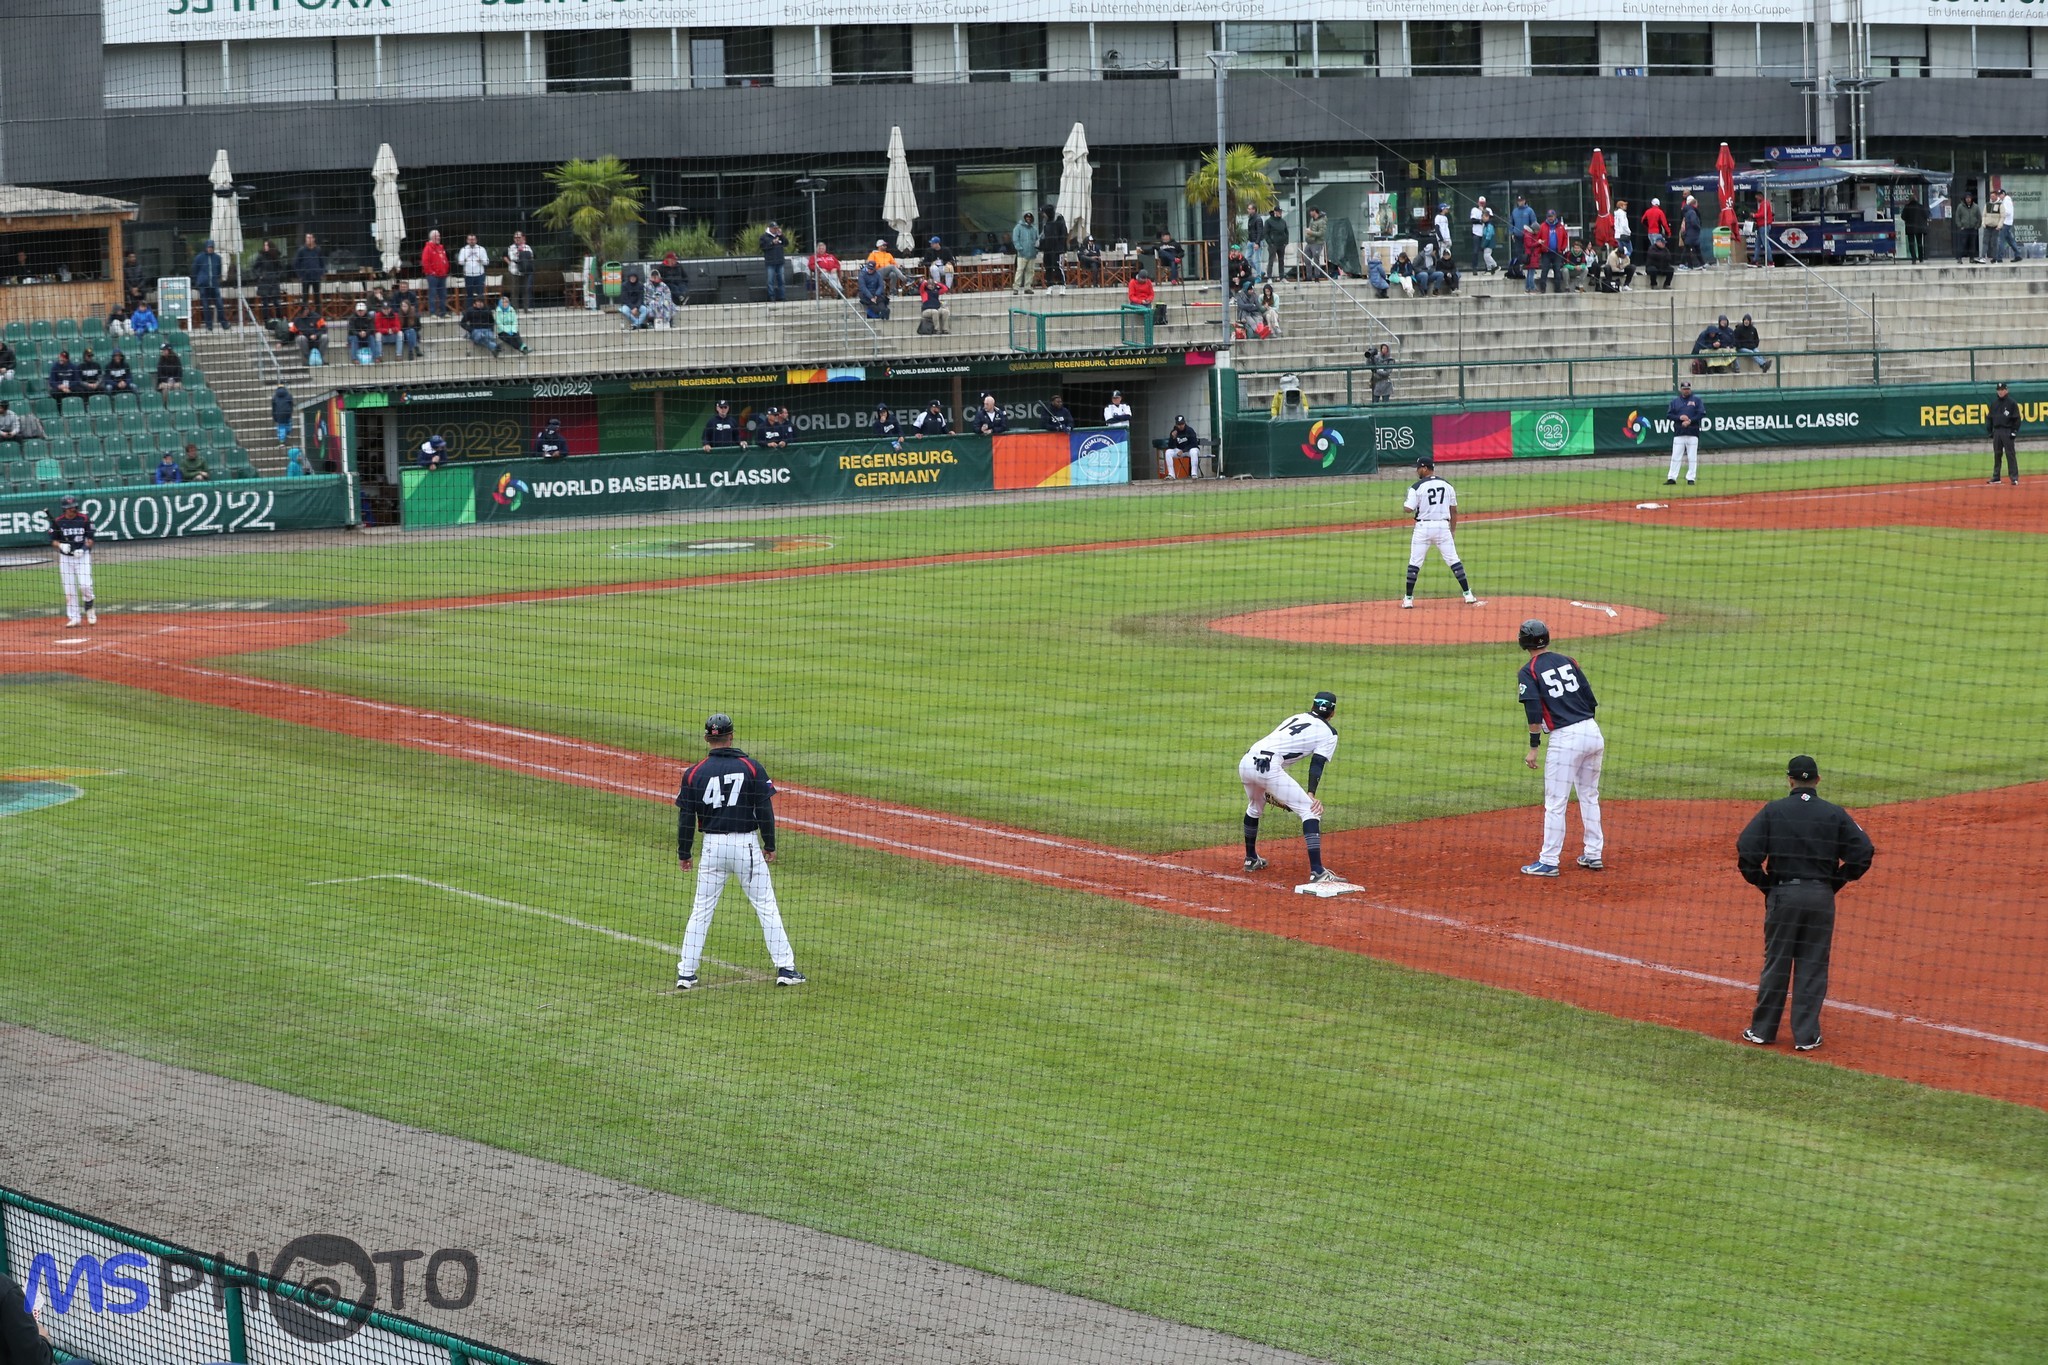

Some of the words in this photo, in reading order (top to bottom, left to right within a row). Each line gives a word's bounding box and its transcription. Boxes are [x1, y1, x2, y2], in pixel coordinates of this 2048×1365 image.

[479, 11, 499, 23] Ein
[503, 10, 589, 23] Unternehmen
[594, 9, 616, 20] der
[620, 8, 697, 21] Aon-Gruppe
[784, 5, 802, 17] Ein
[805, 4, 889, 17] Unternehmen
[892, 4, 912, 15] der
[916, 4, 990, 18] Aon-Gruppe
[1071, 3, 1088, 13] Ein
[1092, 2, 1170, 14] Unternehmen
[1173, 2, 1192, 13] der
[1196, 2, 1264, 16] Aon-Gruppe
[1366, 2, 1383, 13] Ein
[1385, 1, 1459, 13] Unternehmen
[1462, 1, 1480, 13] der
[1483, 2, 1547, 15] Aon-Gruppe
[1622, 3, 1637, 13] Ein
[1640, 3, 1709, 14] Unternehmen
[1711, 3, 1728, 14] der
[1731, 4, 1791, 17] Aon-Gruppe
[1928, 7, 1942, 17] Ein
[1944, 7, 2006, 18] Unternehmen
[2009, 8, 2024, 19] der
[170, 20, 190, 33] Ein
[193, 18, 285, 32] Unternehmen
[289, 17, 312, 30] der
[315, 15, 396, 29] Aon-Gruppe
[1054, 360, 1108, 369] REGENSBURG,
[1109, 357, 1147, 366] GERMANY
[678, 377, 736, 387] REGENSBURG,
[737, 374, 778, 384] GERMANY
[467, 390, 493, 398] CLASSIC
[1715, 414, 1793, 431] BASEBALL
[1796, 412, 1859, 428] CLASSIC
[839, 450, 958, 470] REGENSBURG,
[531, 478, 604, 498] WORLD
[608, 472, 707, 494] BASEBALL
[710, 467, 791, 487] CLASSIC
[854, 468, 940, 487] GERMANY
[1427, 486, 1446, 506] 27
[1541, 664, 1580, 698] 55
[702, 772, 745, 809] 47
